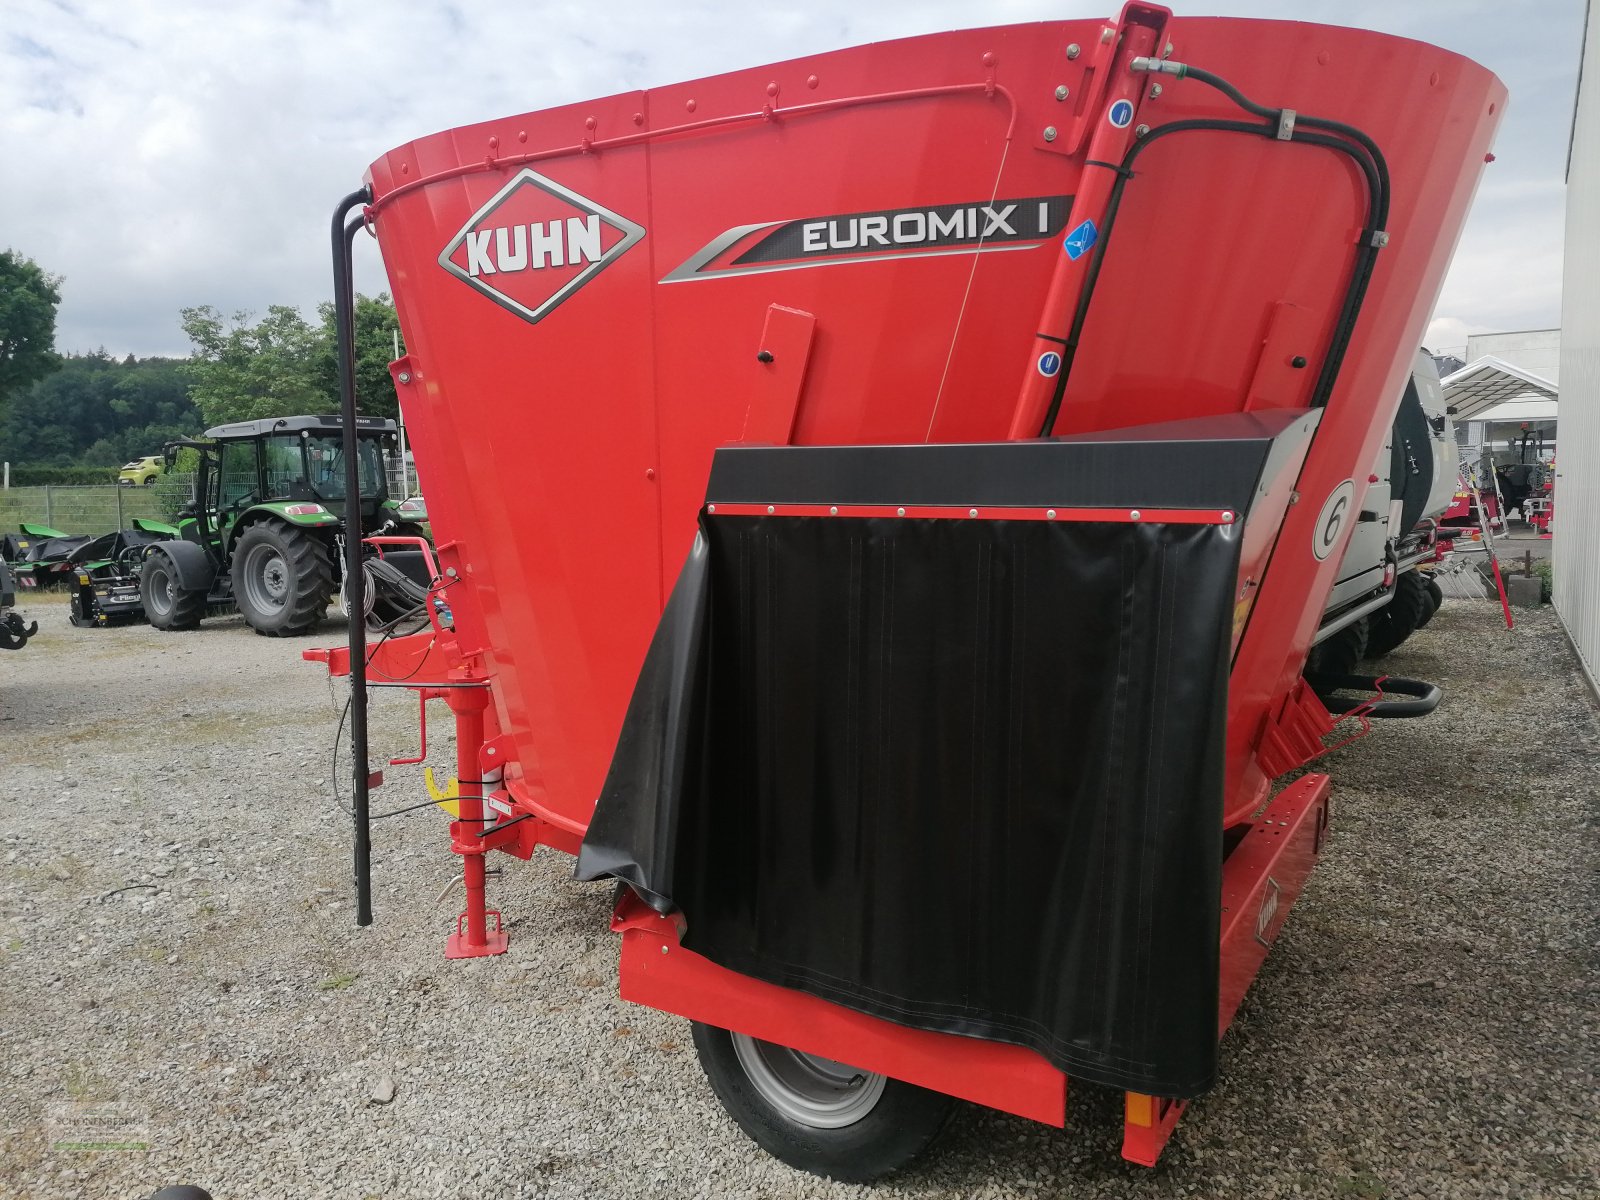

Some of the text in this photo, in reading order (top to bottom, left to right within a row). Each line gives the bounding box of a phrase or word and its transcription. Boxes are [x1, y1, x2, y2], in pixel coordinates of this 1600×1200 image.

[465, 214, 602, 278] KUHN
[802, 202, 1048, 253] EUROMIX I
[1323, 495, 1347, 547] 6
